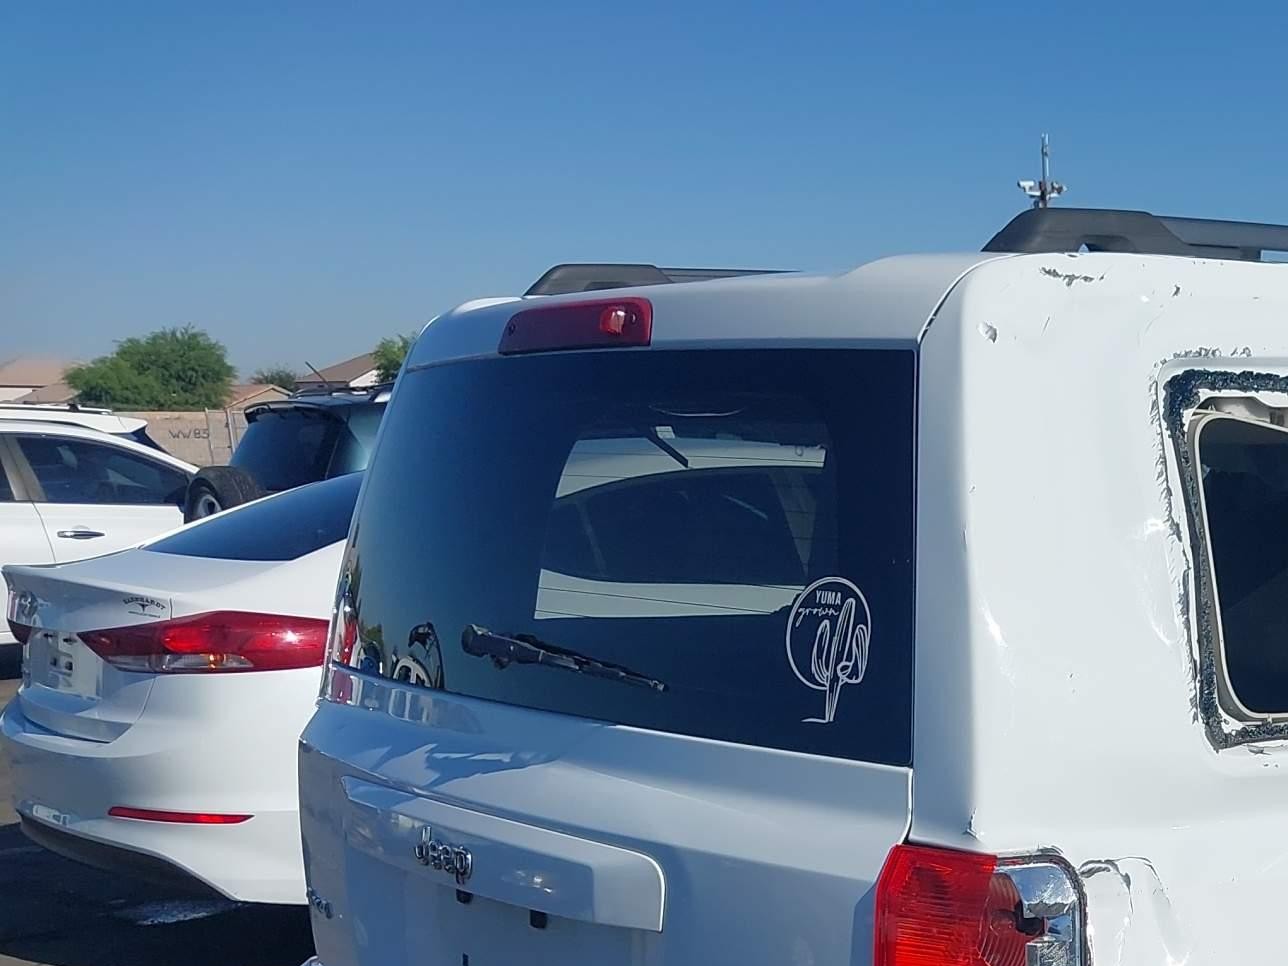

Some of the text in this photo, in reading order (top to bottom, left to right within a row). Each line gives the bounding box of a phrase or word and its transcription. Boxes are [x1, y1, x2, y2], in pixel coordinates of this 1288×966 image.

[815, 589, 842, 606] YUMA
[795, 607, 840, 628] grown
[414, 825, 473, 885] Jeep
